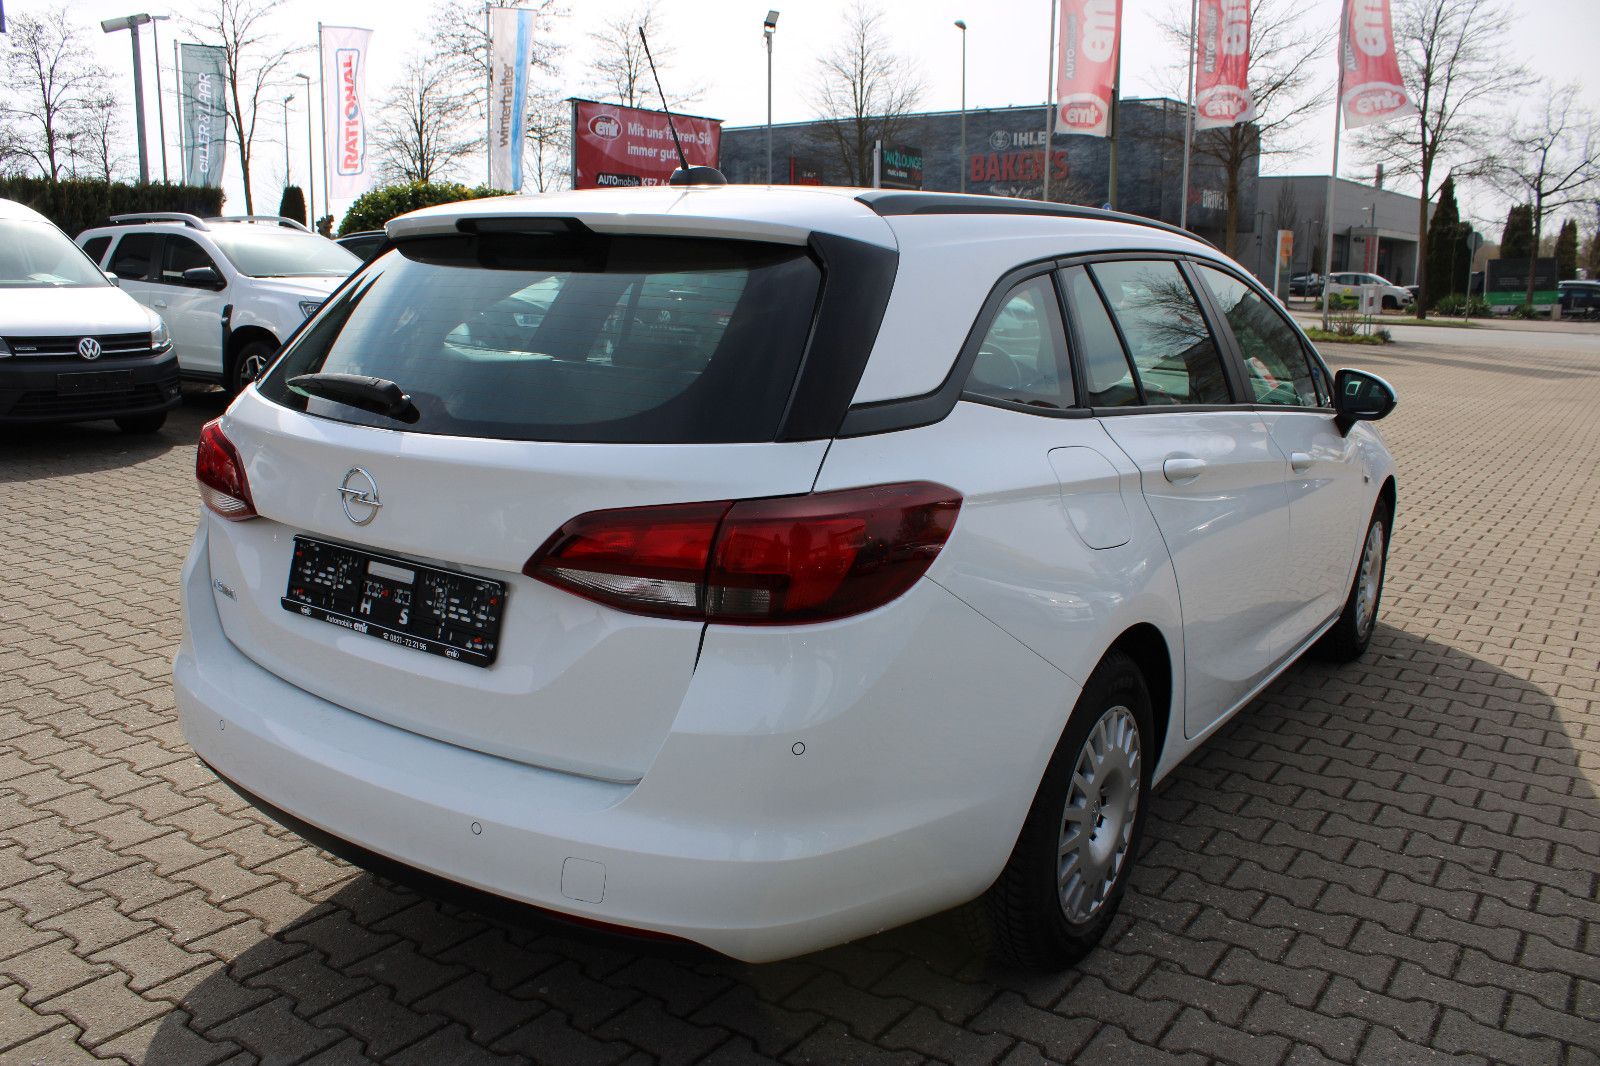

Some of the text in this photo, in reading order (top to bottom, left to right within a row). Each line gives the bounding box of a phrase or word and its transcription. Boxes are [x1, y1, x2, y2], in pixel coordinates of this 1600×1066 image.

[198, 72, 212, 112] LAAR
[343, 55, 359, 170] RATIONAL
[500, 63, 514, 148] winterhalter
[1066, 104, 1099, 124] emir
[595, 119, 619, 137] emir
[627, 122, 711, 145] Mit uns fahren Sie
[1013, 131, 1047, 146] IHLE
[627, 141, 657, 157] immer
[597, 174, 639, 187] AUTOmobile
[326, 614, 368, 634] Automobile emir
